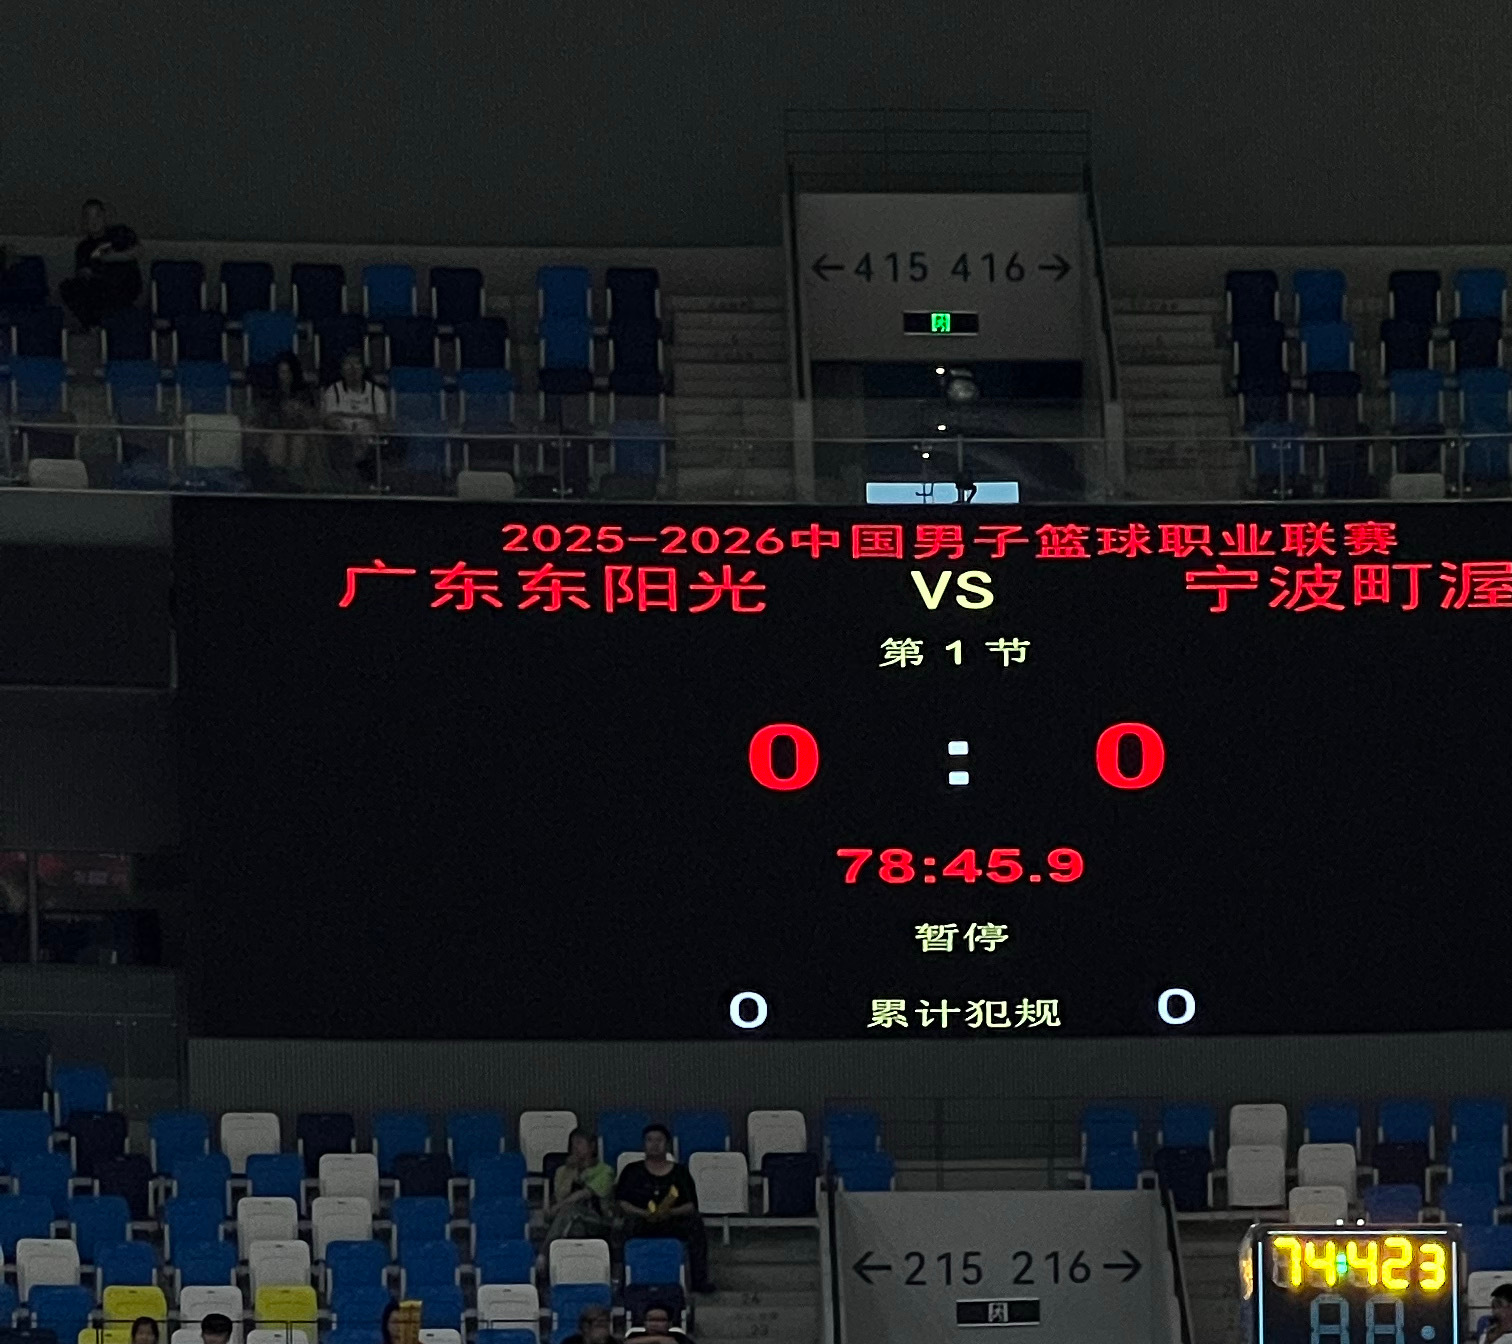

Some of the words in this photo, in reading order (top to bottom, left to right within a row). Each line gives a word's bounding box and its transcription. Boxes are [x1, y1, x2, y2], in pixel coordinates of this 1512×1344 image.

[853, 252, 929, 282] 415
[950, 252, 1026, 282] 416
[338, 559, 767, 614] 广东东阳光
[911, 571, 994, 610] VS
[748, 722, 820, 792] 0
[1095, 722, 1166, 791] 0
[836, 847, 1085, 884] 78:45.9
[914, 921, 1009, 953] 暂停
[729, 991, 768, 1029] 0
[866, 997, 1062, 1029] 累计犯规
[1157, 987, 1196, 1025] 0
[904, 1251, 984, 1286] 215
[1011, 1251, 1092, 1286] 216
